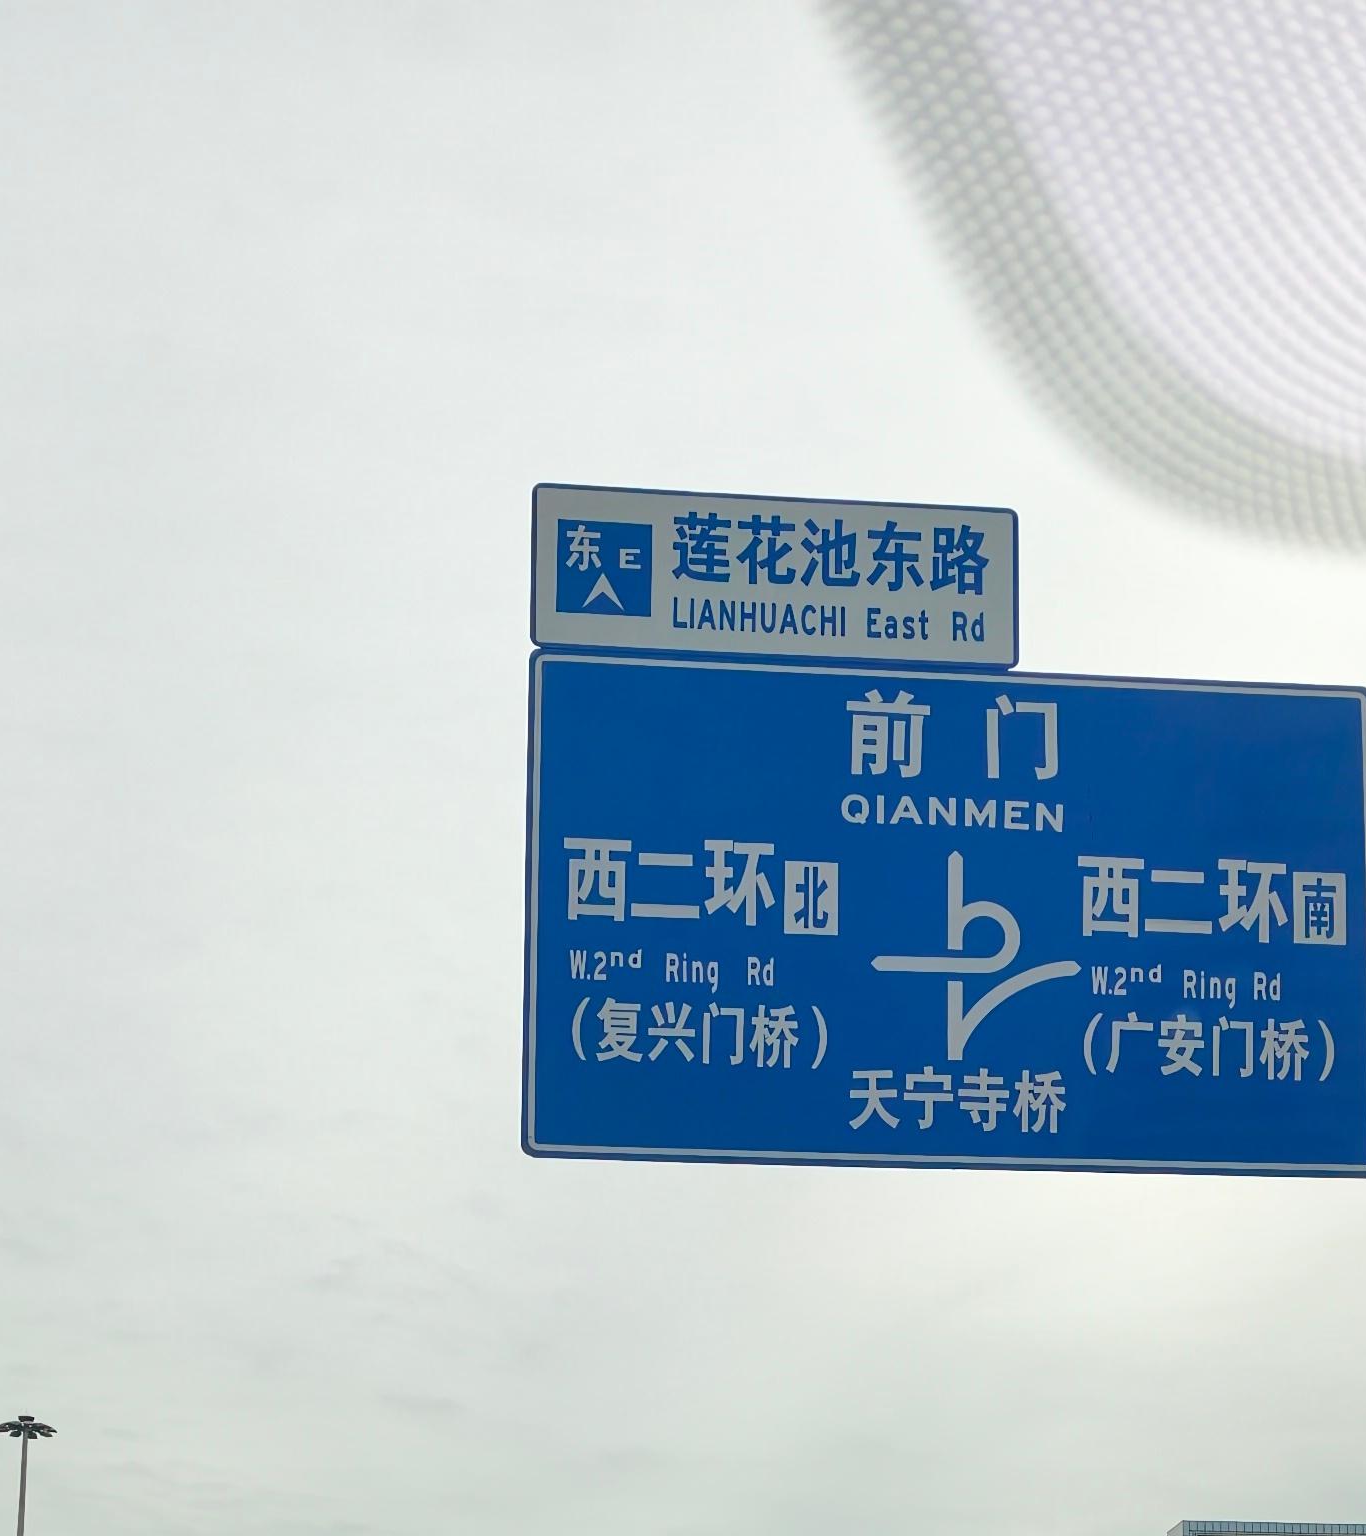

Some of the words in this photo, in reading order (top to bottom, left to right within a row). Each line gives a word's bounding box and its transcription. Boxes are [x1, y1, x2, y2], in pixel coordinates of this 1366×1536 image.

[566, 525, 602, 572] 东
[619, 549, 641, 569] E
[671, 511, 990, 596] 莲花池东路
[672, 596, 846, 638] LIANHUACHI
[867, 607, 929, 641] East
[952, 611, 986, 643] Rd
[841, 794, 1064, 833] QIANMEN
[666, 952, 719, 993] Ring
[747, 957, 774, 986] Rd
[1184, 970, 1235, 1008] Ring
[1254, 972, 1281, 1001] Rd
[571, 997, 828, 1070] (复兴门桥)
[1084, 1011, 1335, 1082] (广安门桥)
[849, 1066, 1066, 1134] 天宁寺桥
